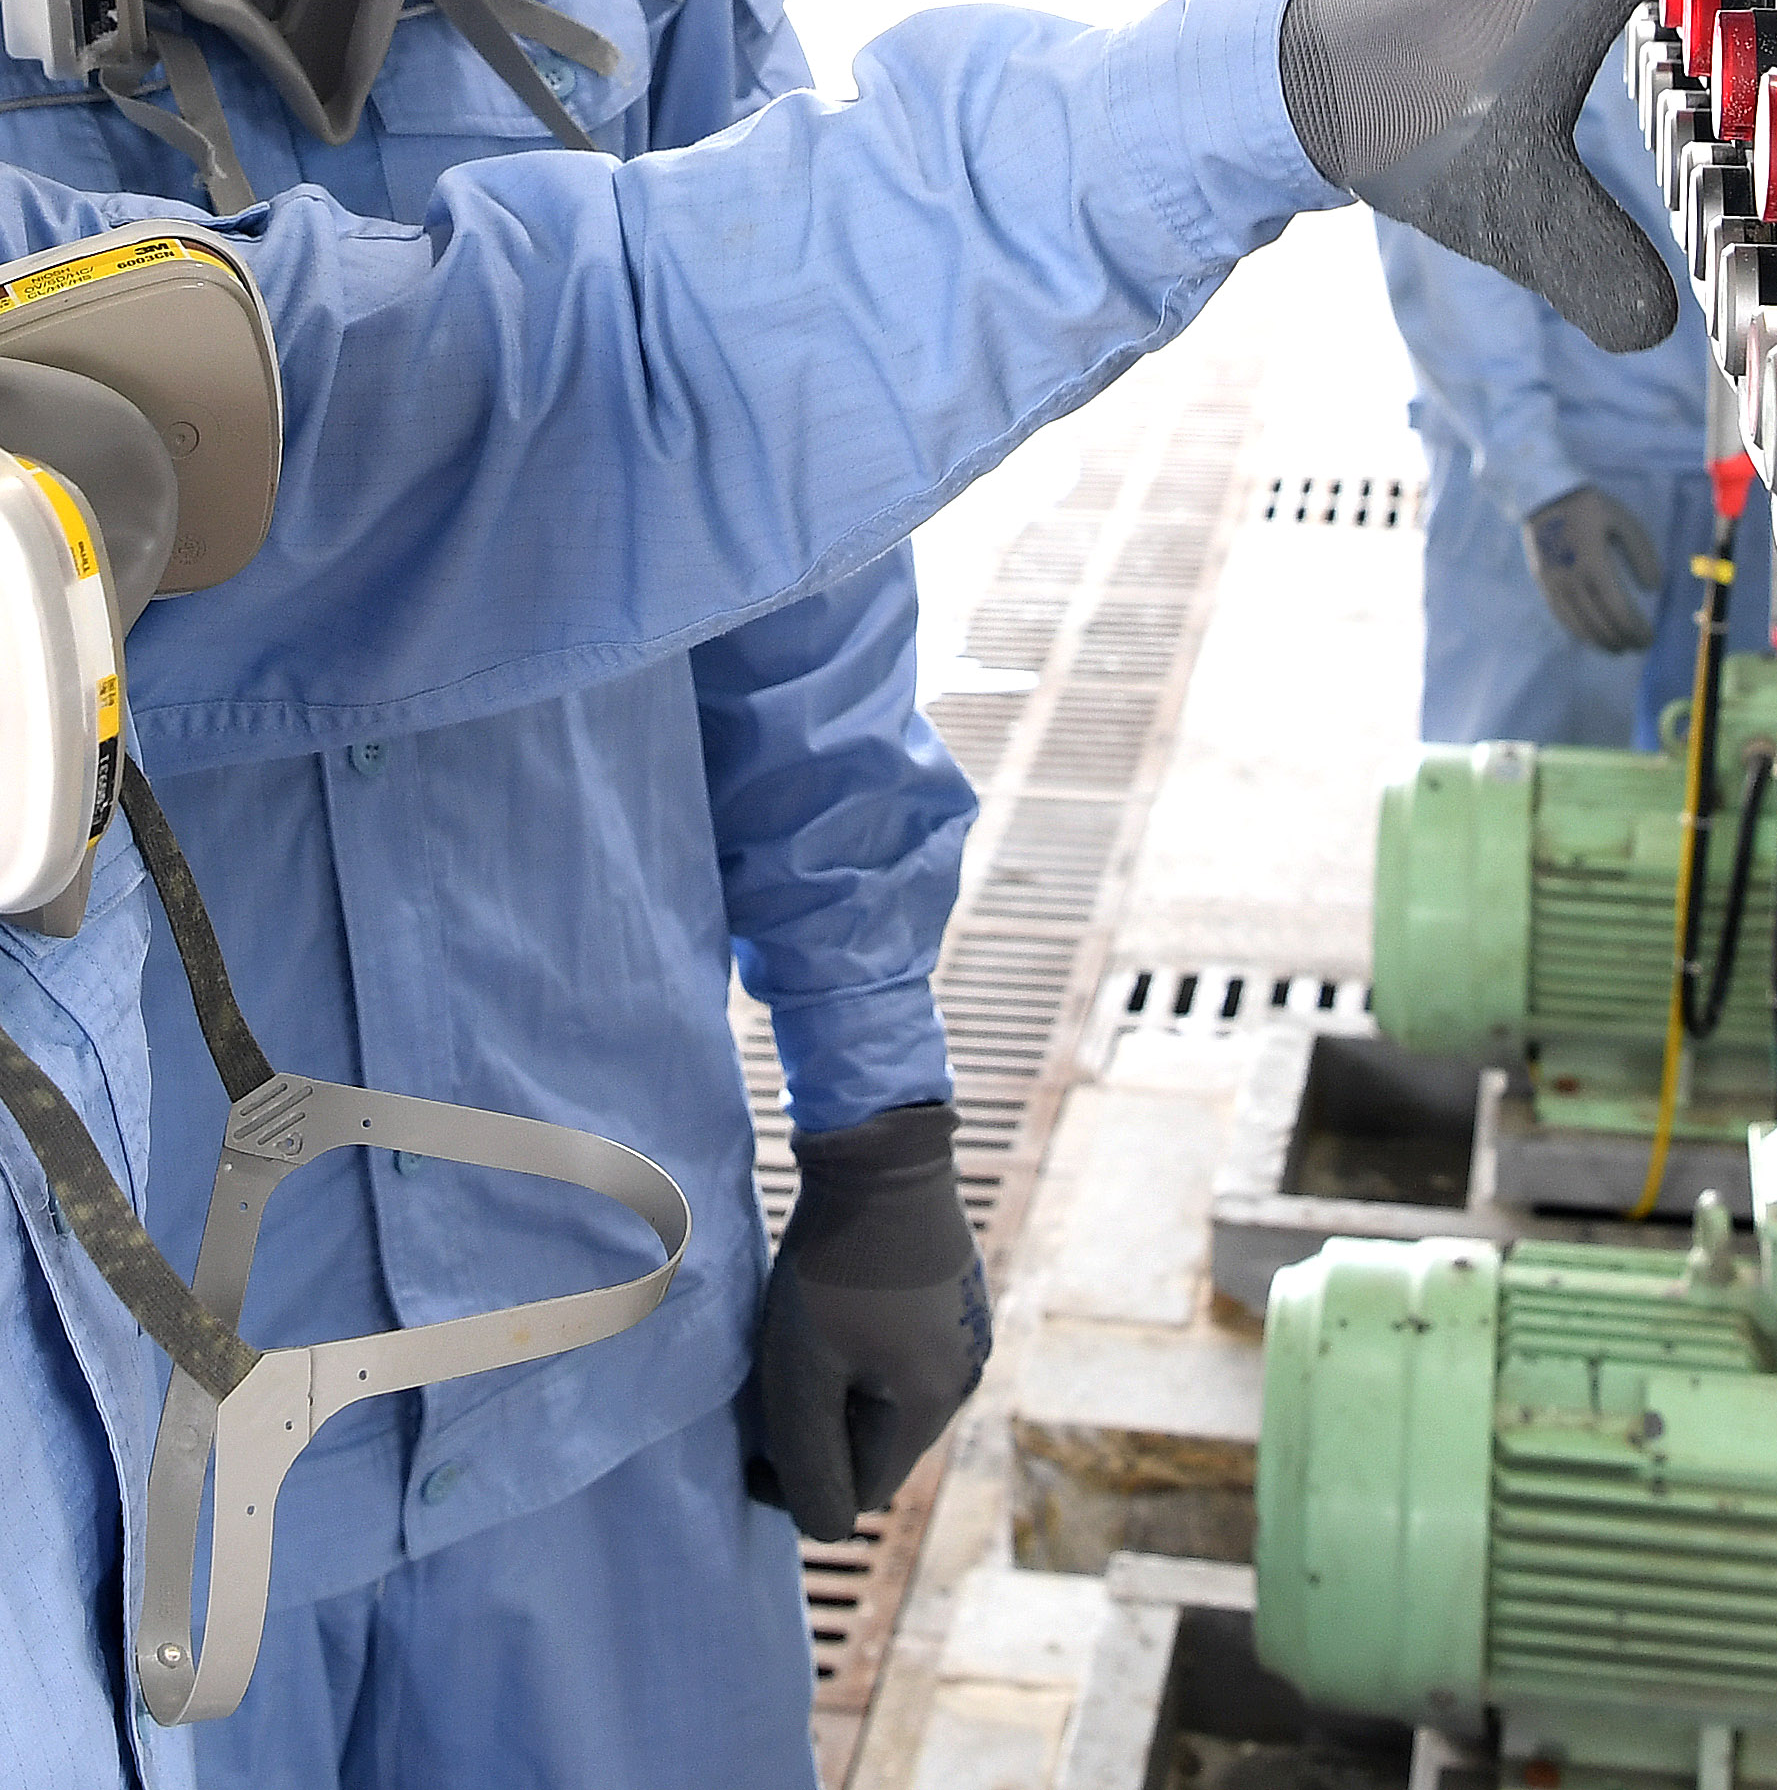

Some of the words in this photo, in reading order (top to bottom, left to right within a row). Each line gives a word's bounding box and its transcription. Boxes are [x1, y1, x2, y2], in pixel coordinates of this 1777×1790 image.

[134, 242, 170, 256] 3M
[116, 250, 176, 270] 6003CN
[31, 267, 71, 284] NIOSH
